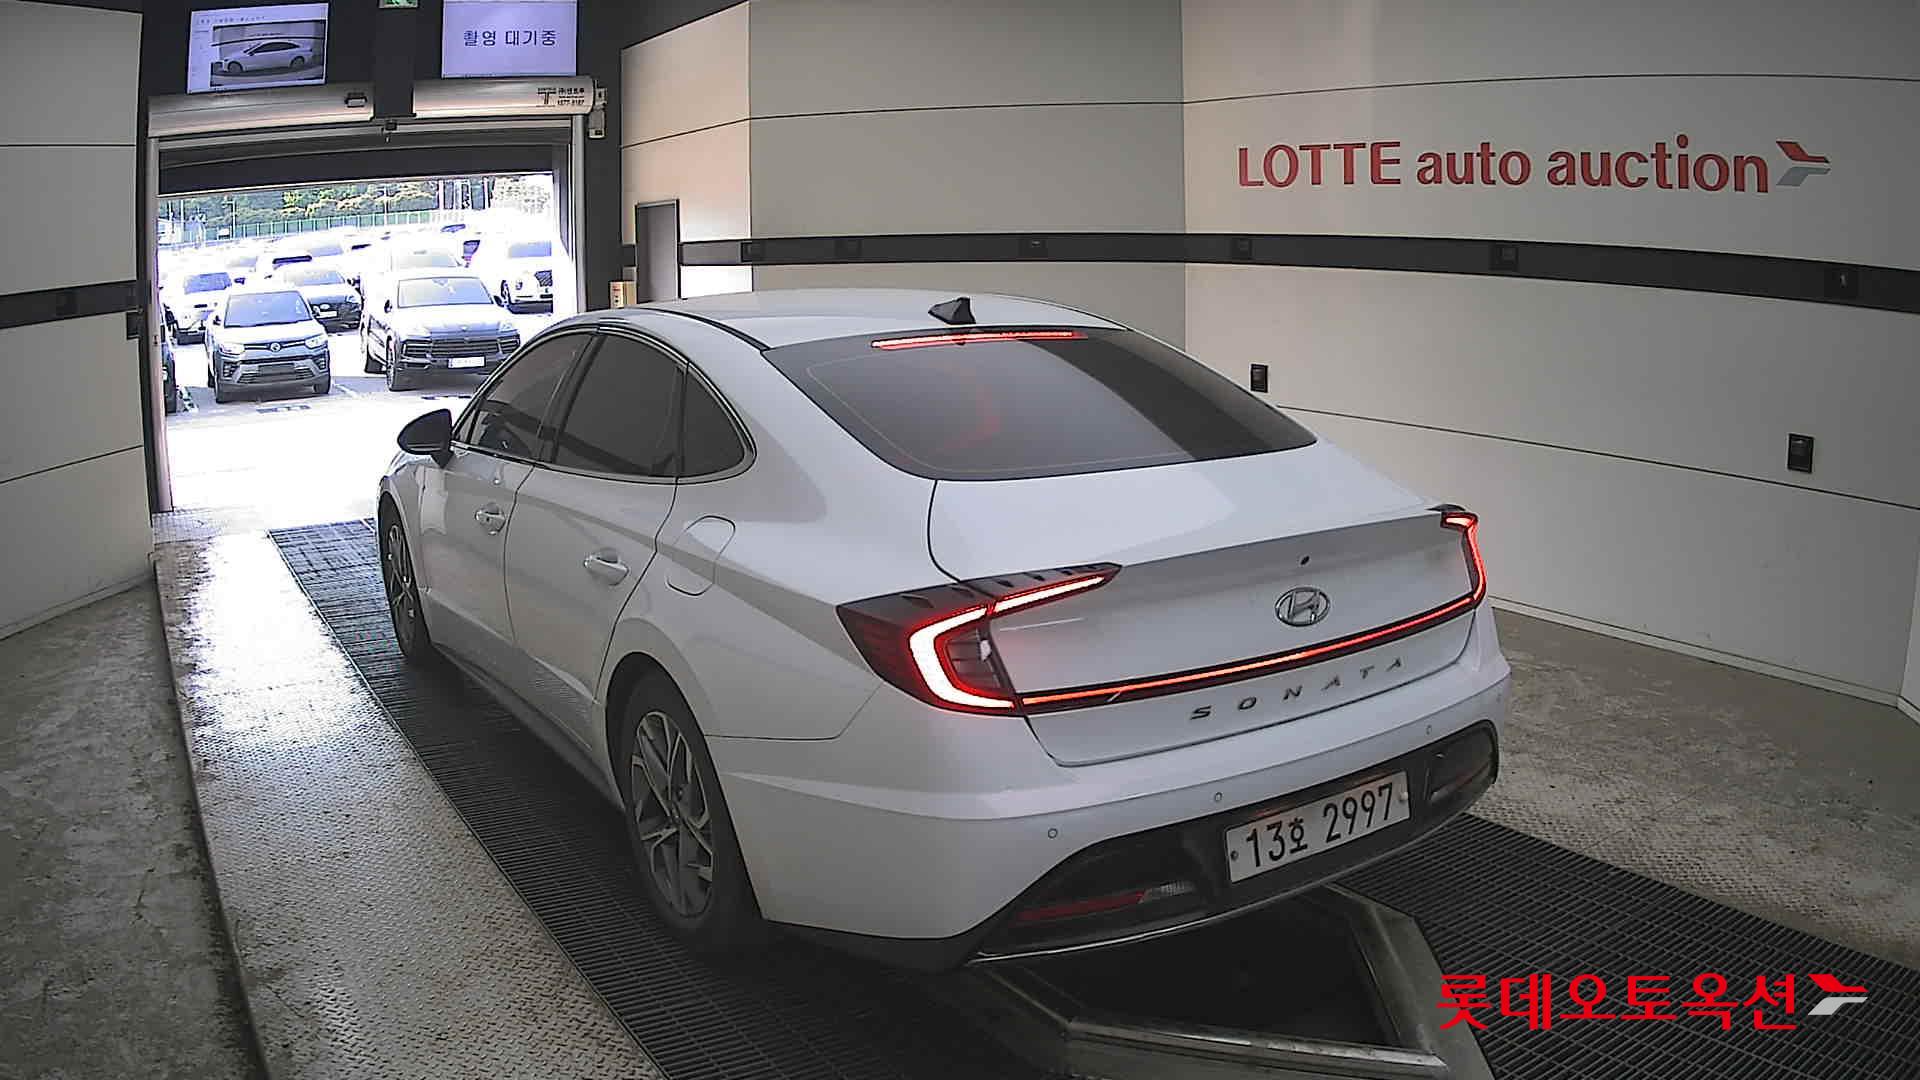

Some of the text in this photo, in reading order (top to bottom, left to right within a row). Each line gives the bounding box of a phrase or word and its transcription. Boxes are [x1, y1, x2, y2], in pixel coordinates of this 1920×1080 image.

[505, 30, 557, 46] 대기중
[1238, 134, 1768, 193] LOTTE auto auction
[1190, 658, 1402, 721] SONATA
[1246, 782, 1393, 867] 13호 2997
